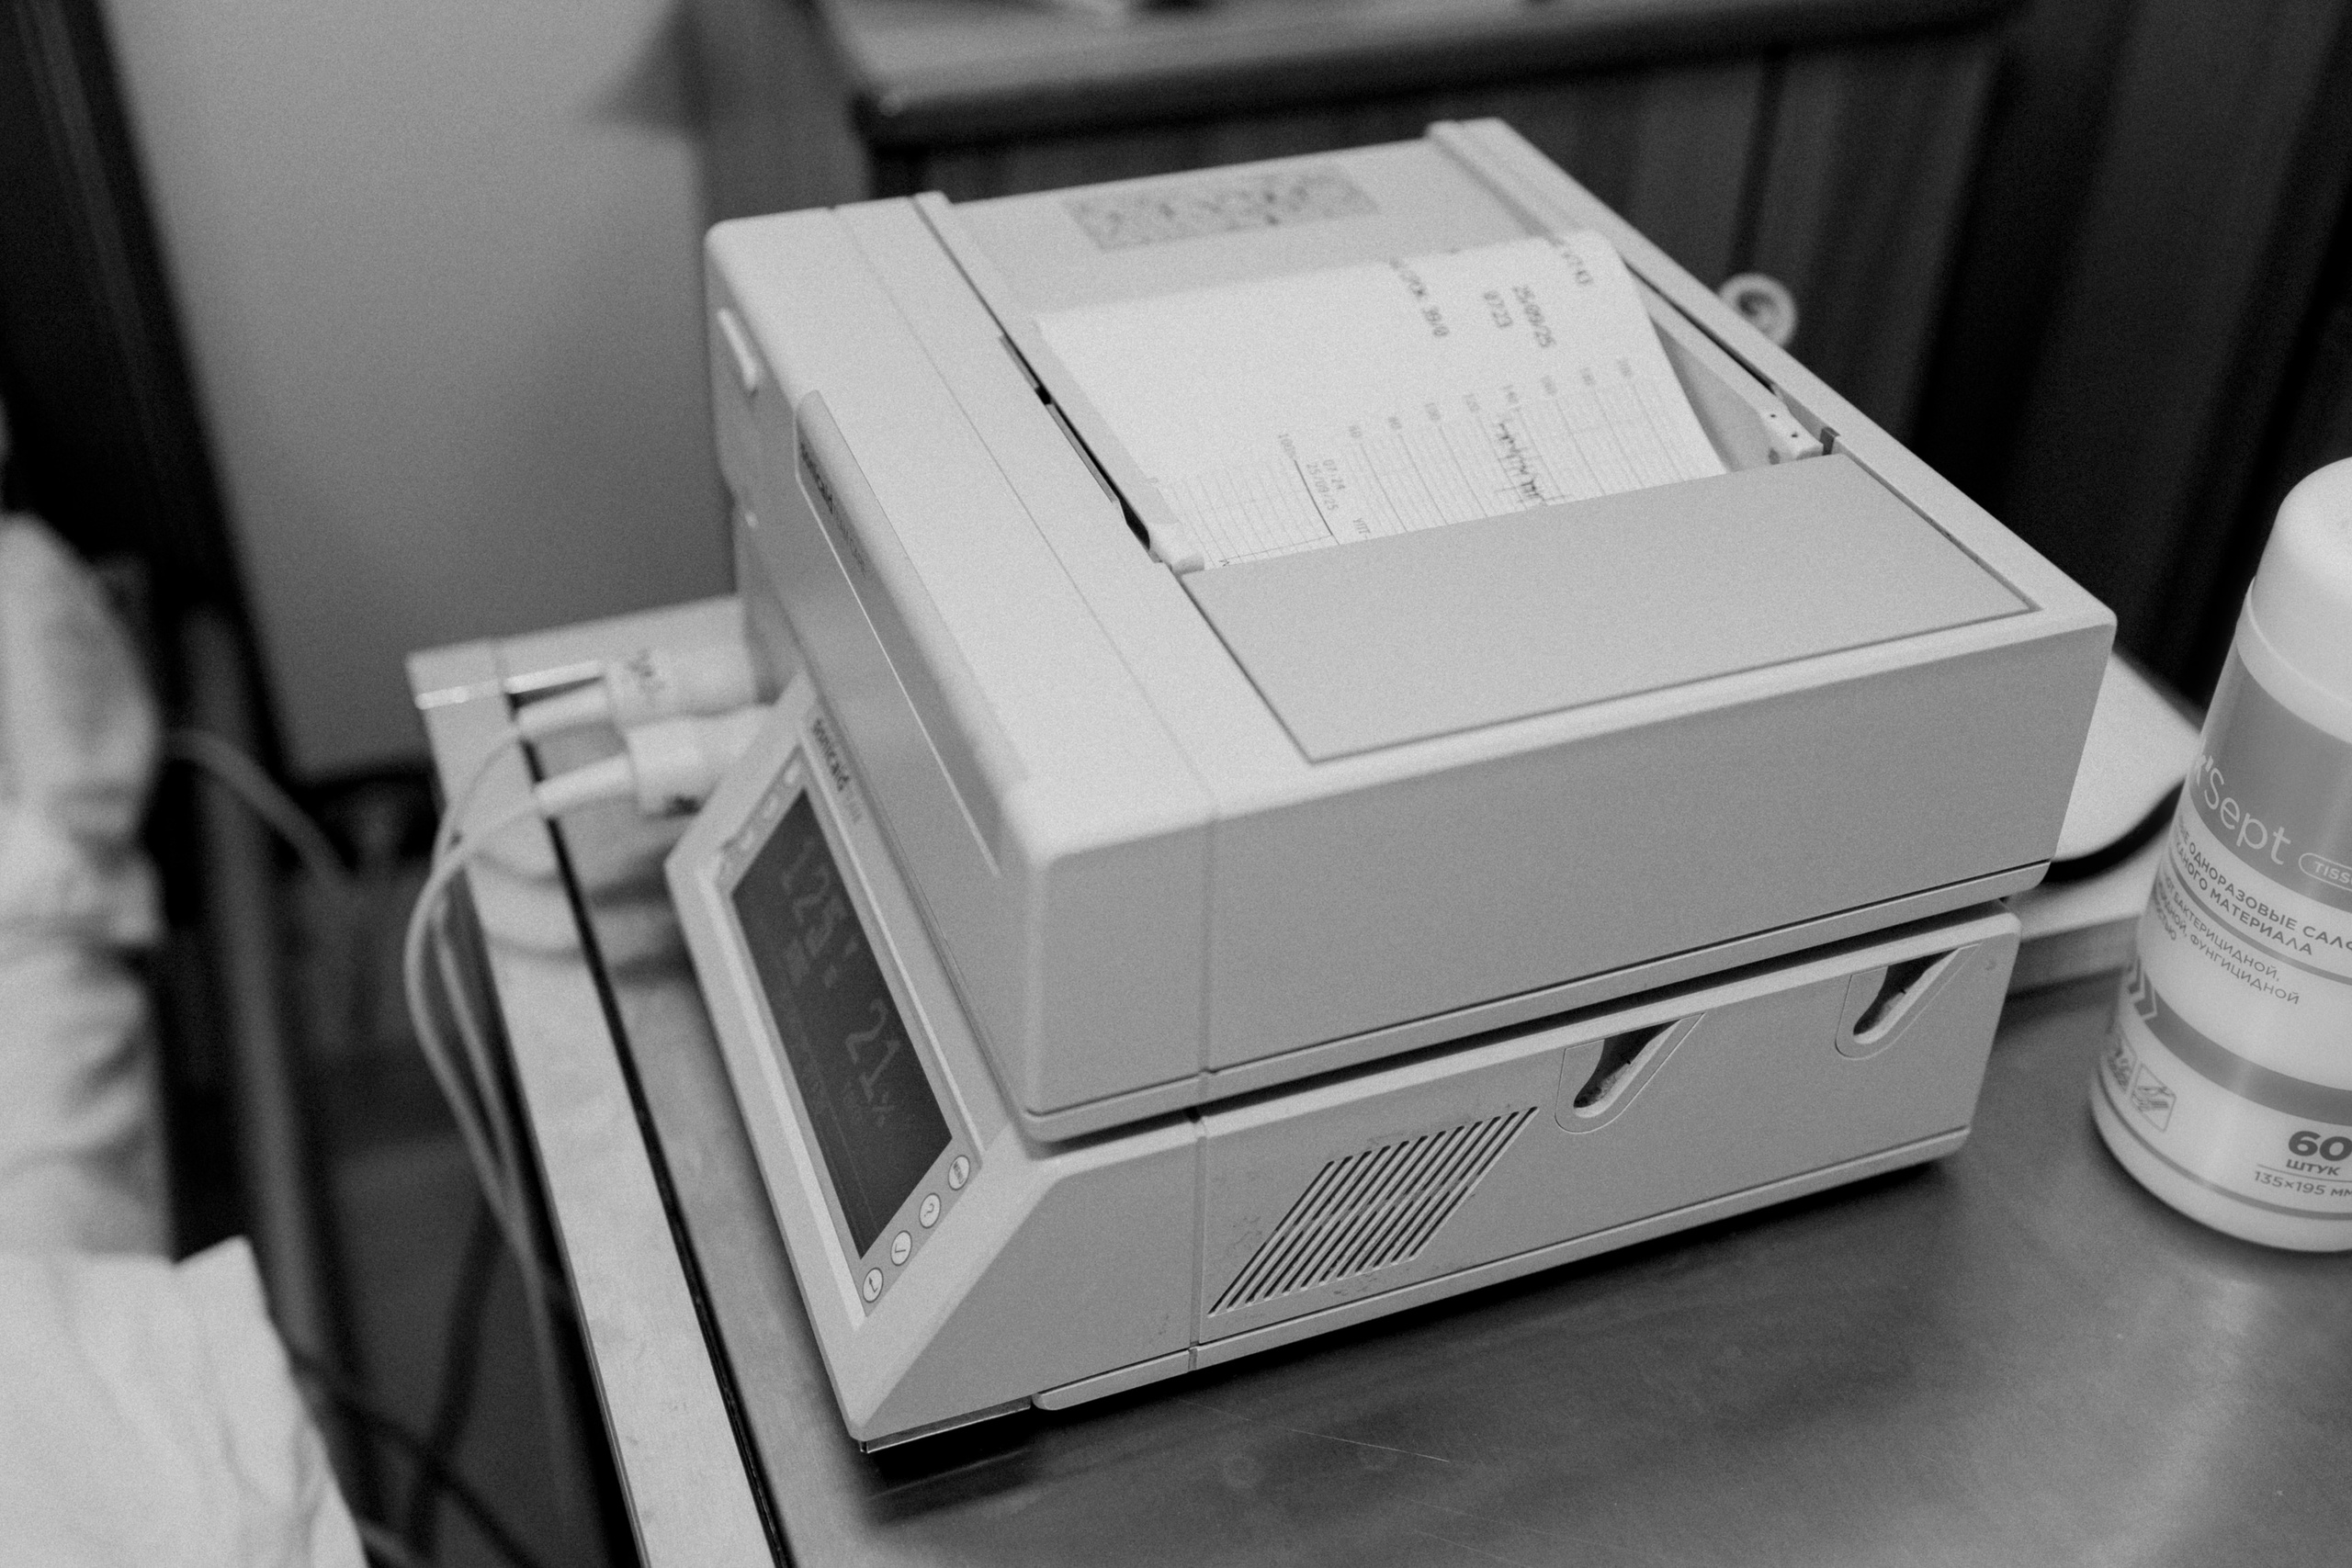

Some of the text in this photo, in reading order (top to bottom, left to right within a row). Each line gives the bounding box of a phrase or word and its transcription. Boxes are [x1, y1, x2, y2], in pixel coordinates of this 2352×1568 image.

[2188, 841, 2298, 931] ОДНОРАЗОВЫЕ
[2313, 860, 2352, 886] TISS
[2210, 887, 2313, 956] МАТЕРИАЛА
[2190, 934, 2301, 1005] ФУНГИЦИДНОЙ
[2286, 1158, 2342, 1177] ШТУК
[2288, 1130, 2352, 1162] 60
